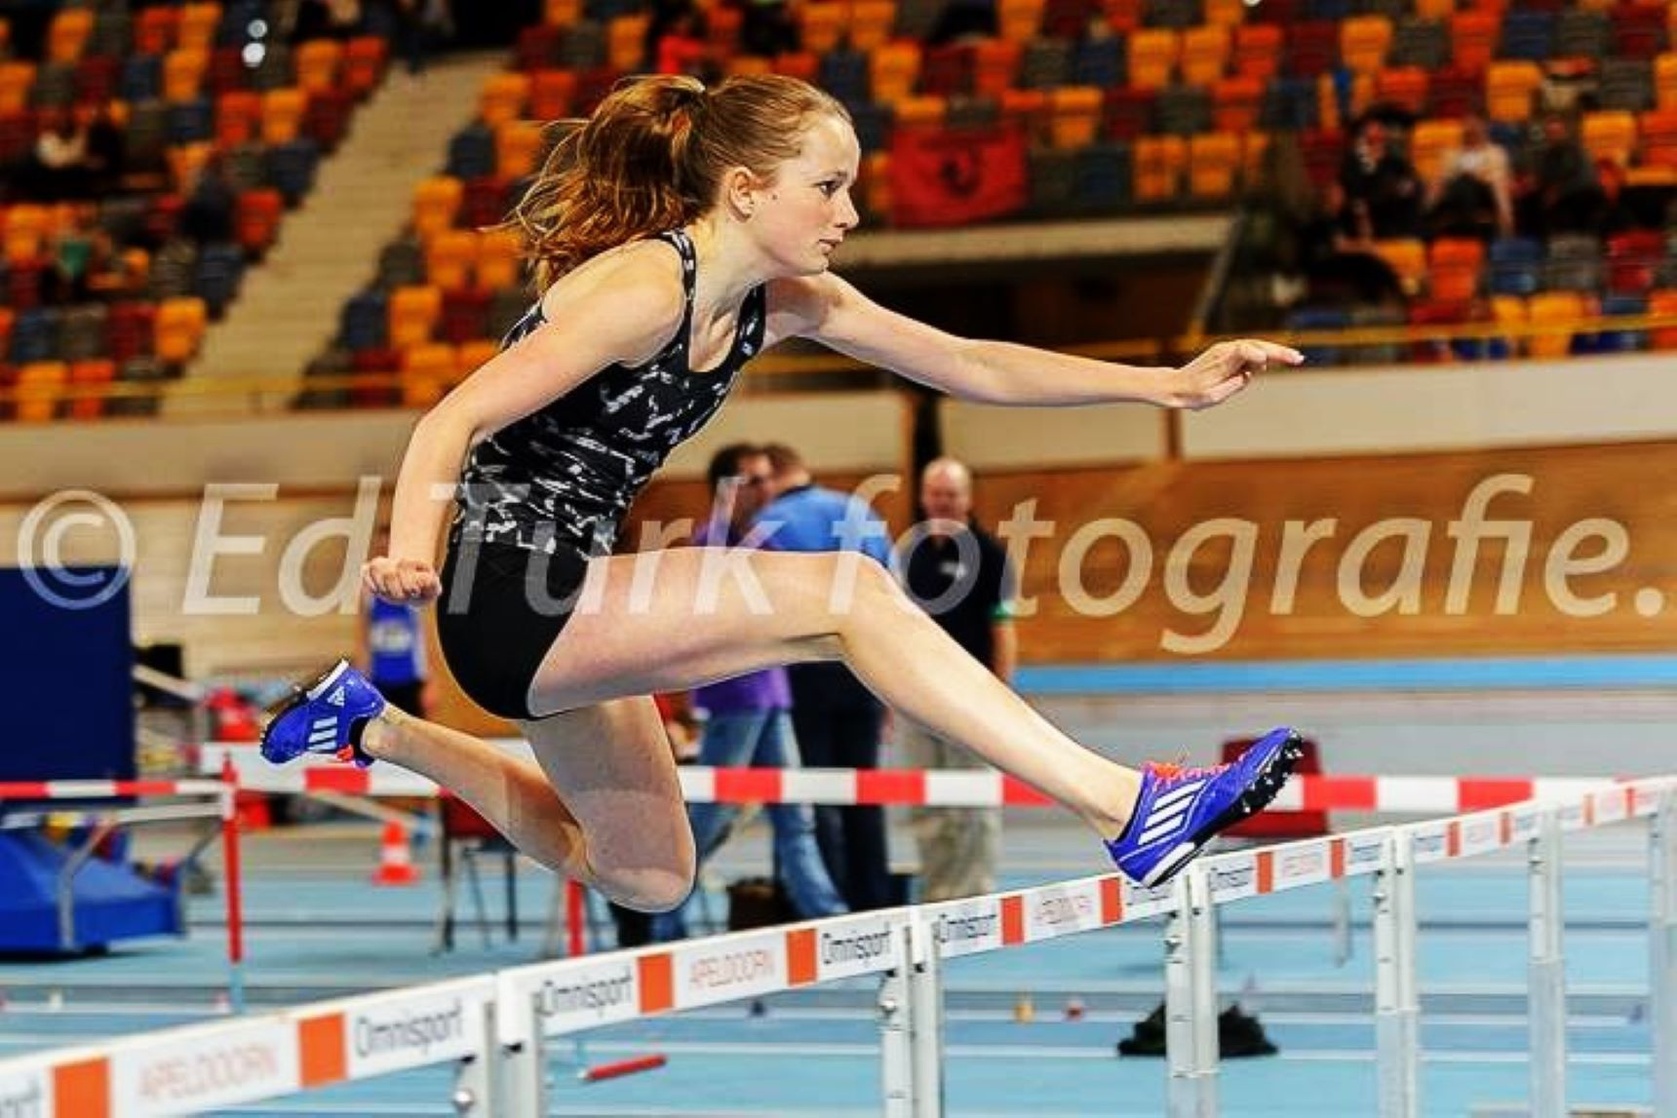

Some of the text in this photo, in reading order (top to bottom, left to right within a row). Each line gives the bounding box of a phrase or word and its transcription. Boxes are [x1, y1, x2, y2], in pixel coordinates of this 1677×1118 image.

[541, 965, 633, 1016] Omnisport
[821, 921, 892, 967] Omnisport
[356, 997, 464, 1057] Omnisport
